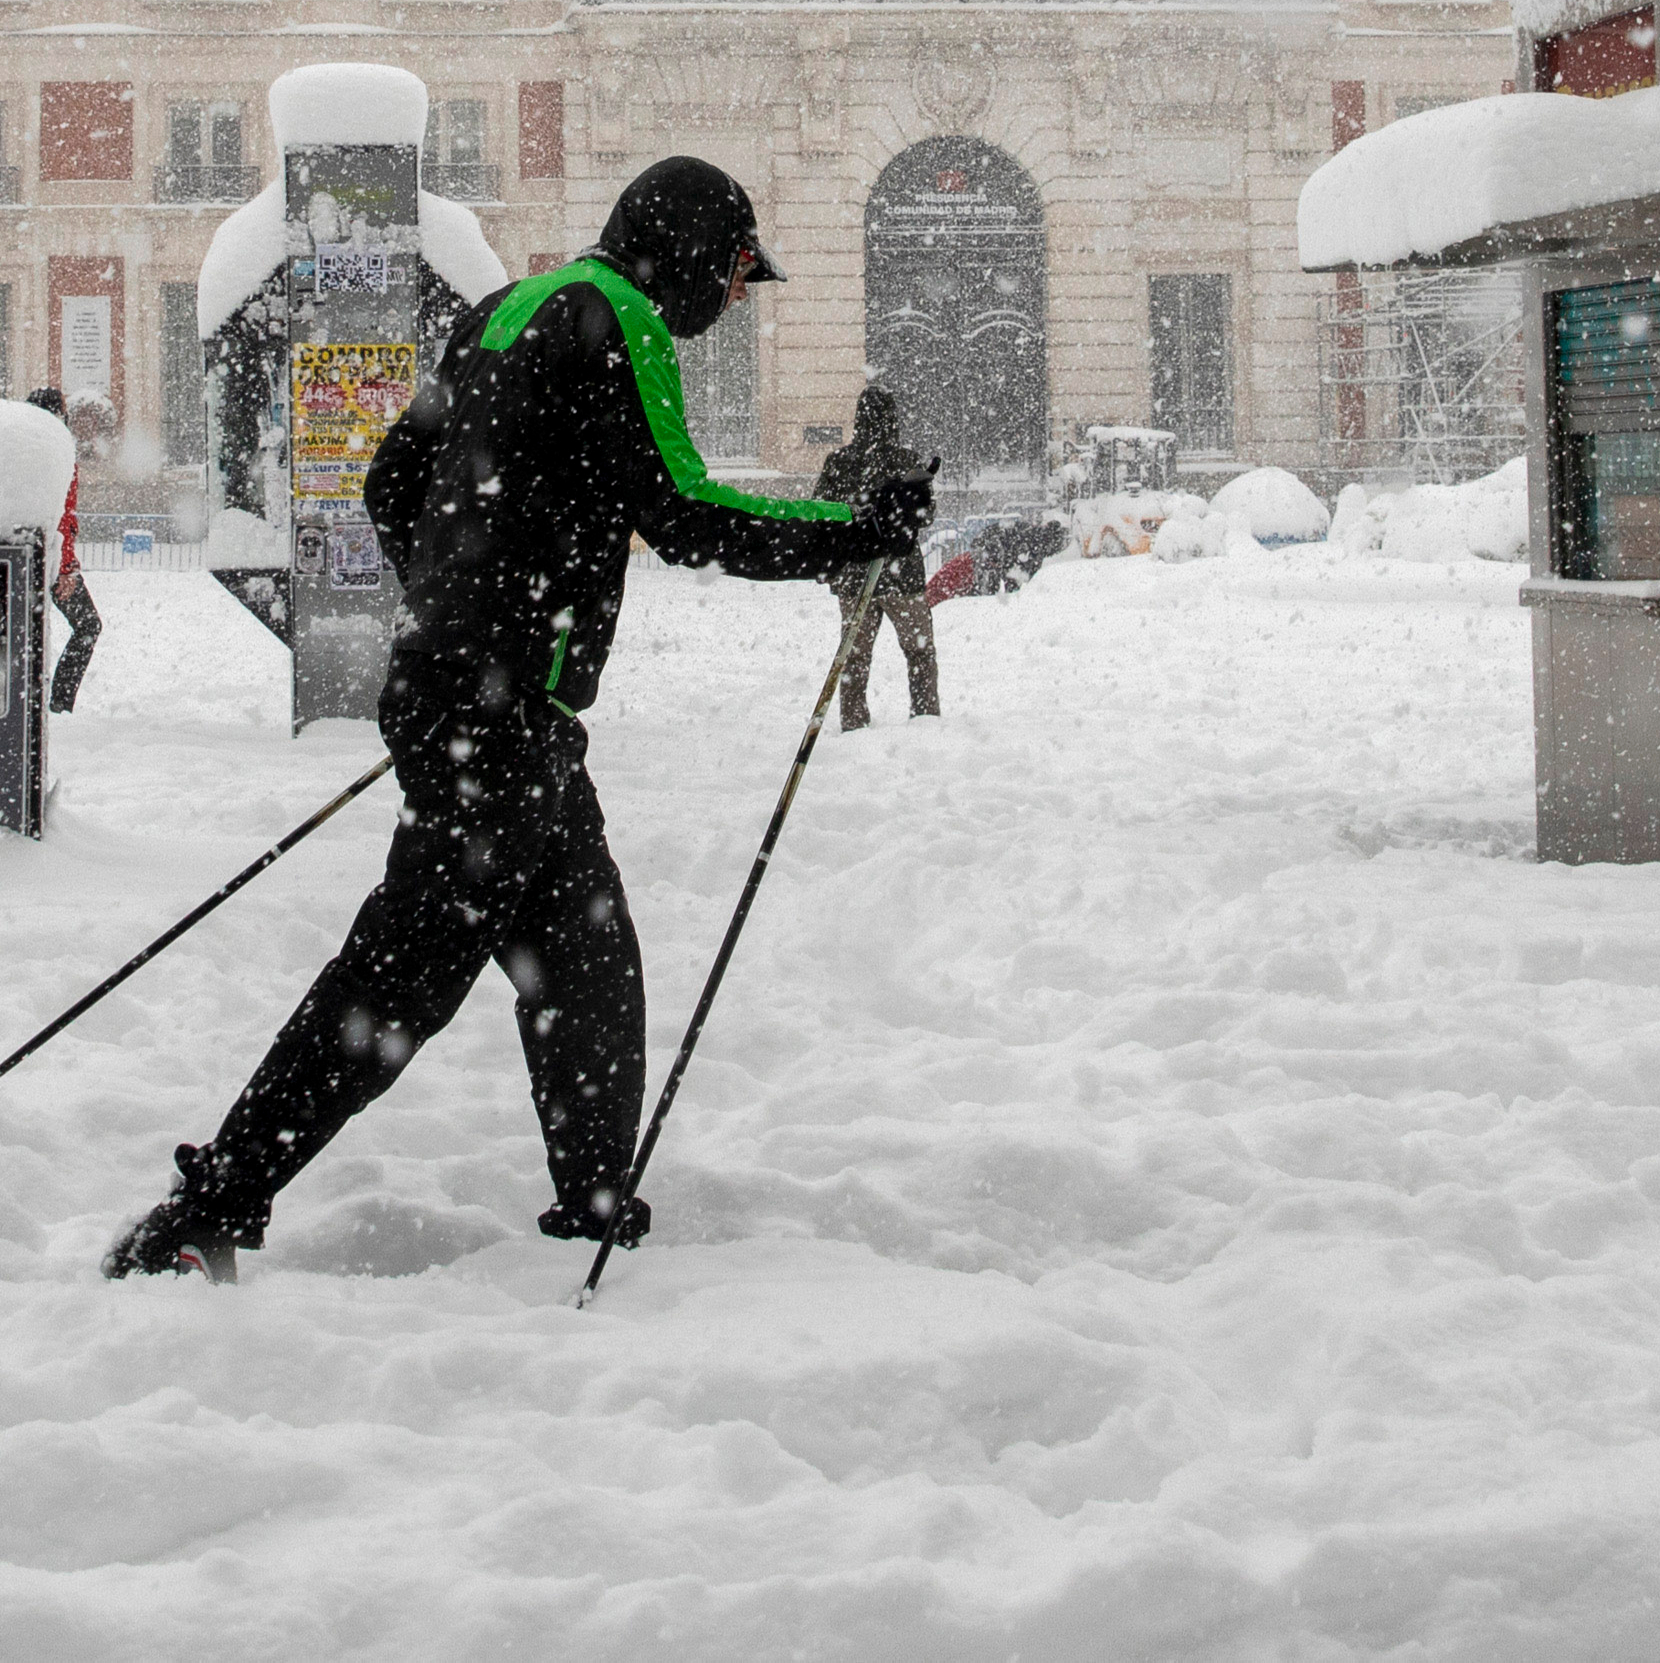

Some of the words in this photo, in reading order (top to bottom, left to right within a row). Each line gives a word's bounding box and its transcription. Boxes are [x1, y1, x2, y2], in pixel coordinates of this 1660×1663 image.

[915, 194, 988, 203] PRESIDENCIA
[886, 206, 952, 215] COMUNIDAD
[956, 206, 972, 215] DE
[300, 347, 412, 365] COMPRO
